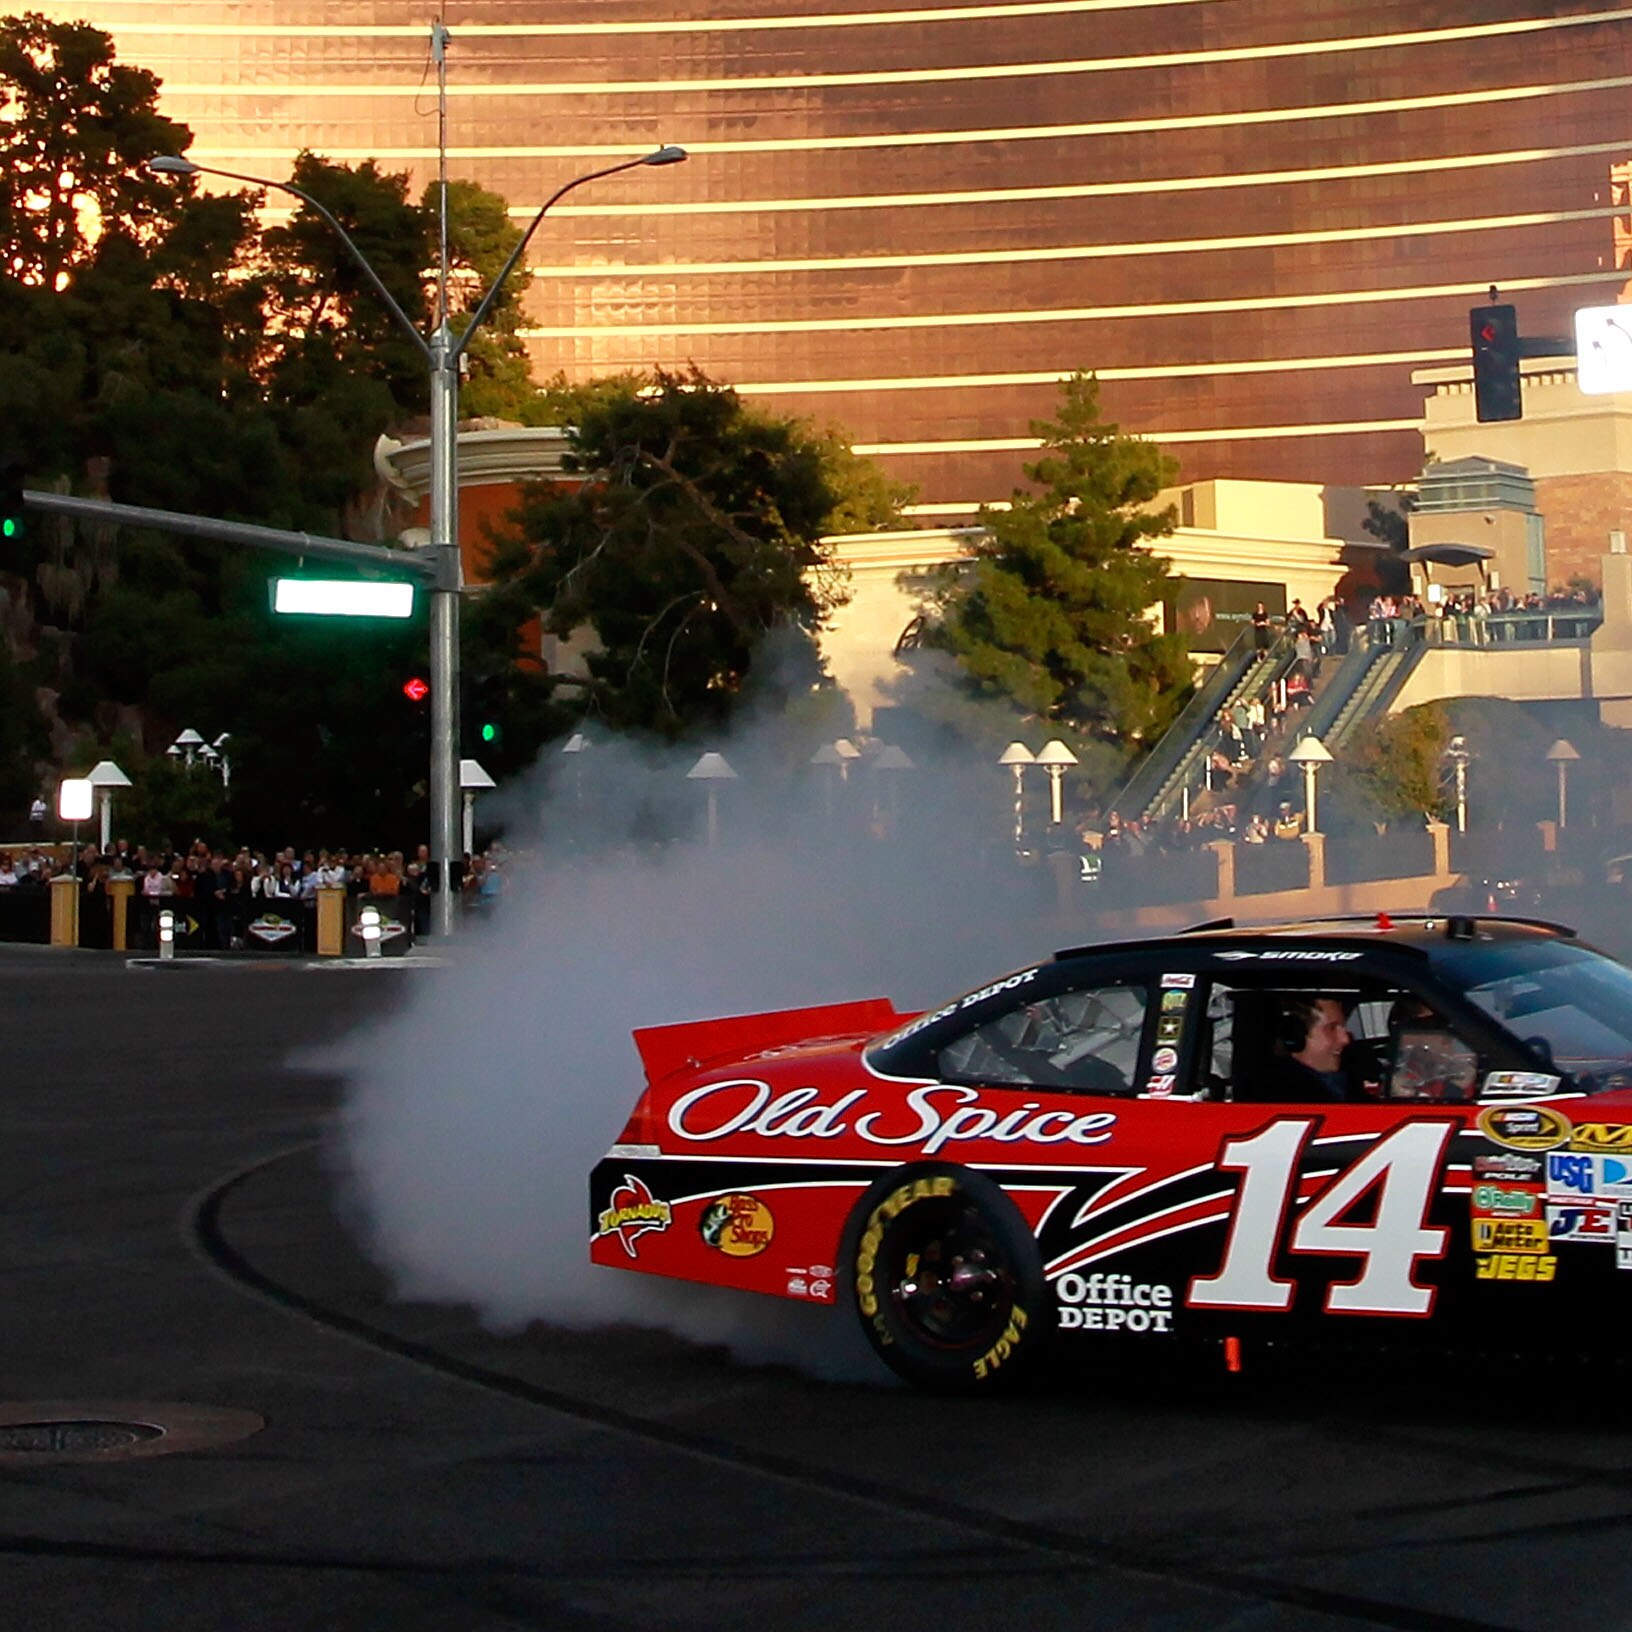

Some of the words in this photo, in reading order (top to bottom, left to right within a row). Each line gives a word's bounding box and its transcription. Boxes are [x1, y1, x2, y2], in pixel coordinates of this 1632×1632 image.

[961, 968, 1039, 1008] DEPOT
[668, 1079, 868, 1141] Old
[854, 1084, 1117, 1155] Spice
[1188, 1118, 1458, 1314] 14
[1475, 1254, 1558, 1281] JEGS
[1056, 1273, 1173, 1307] Office
[1057, 1306, 1173, 1333] DEPOT
[972, 1303, 1028, 1380] EAGLE
